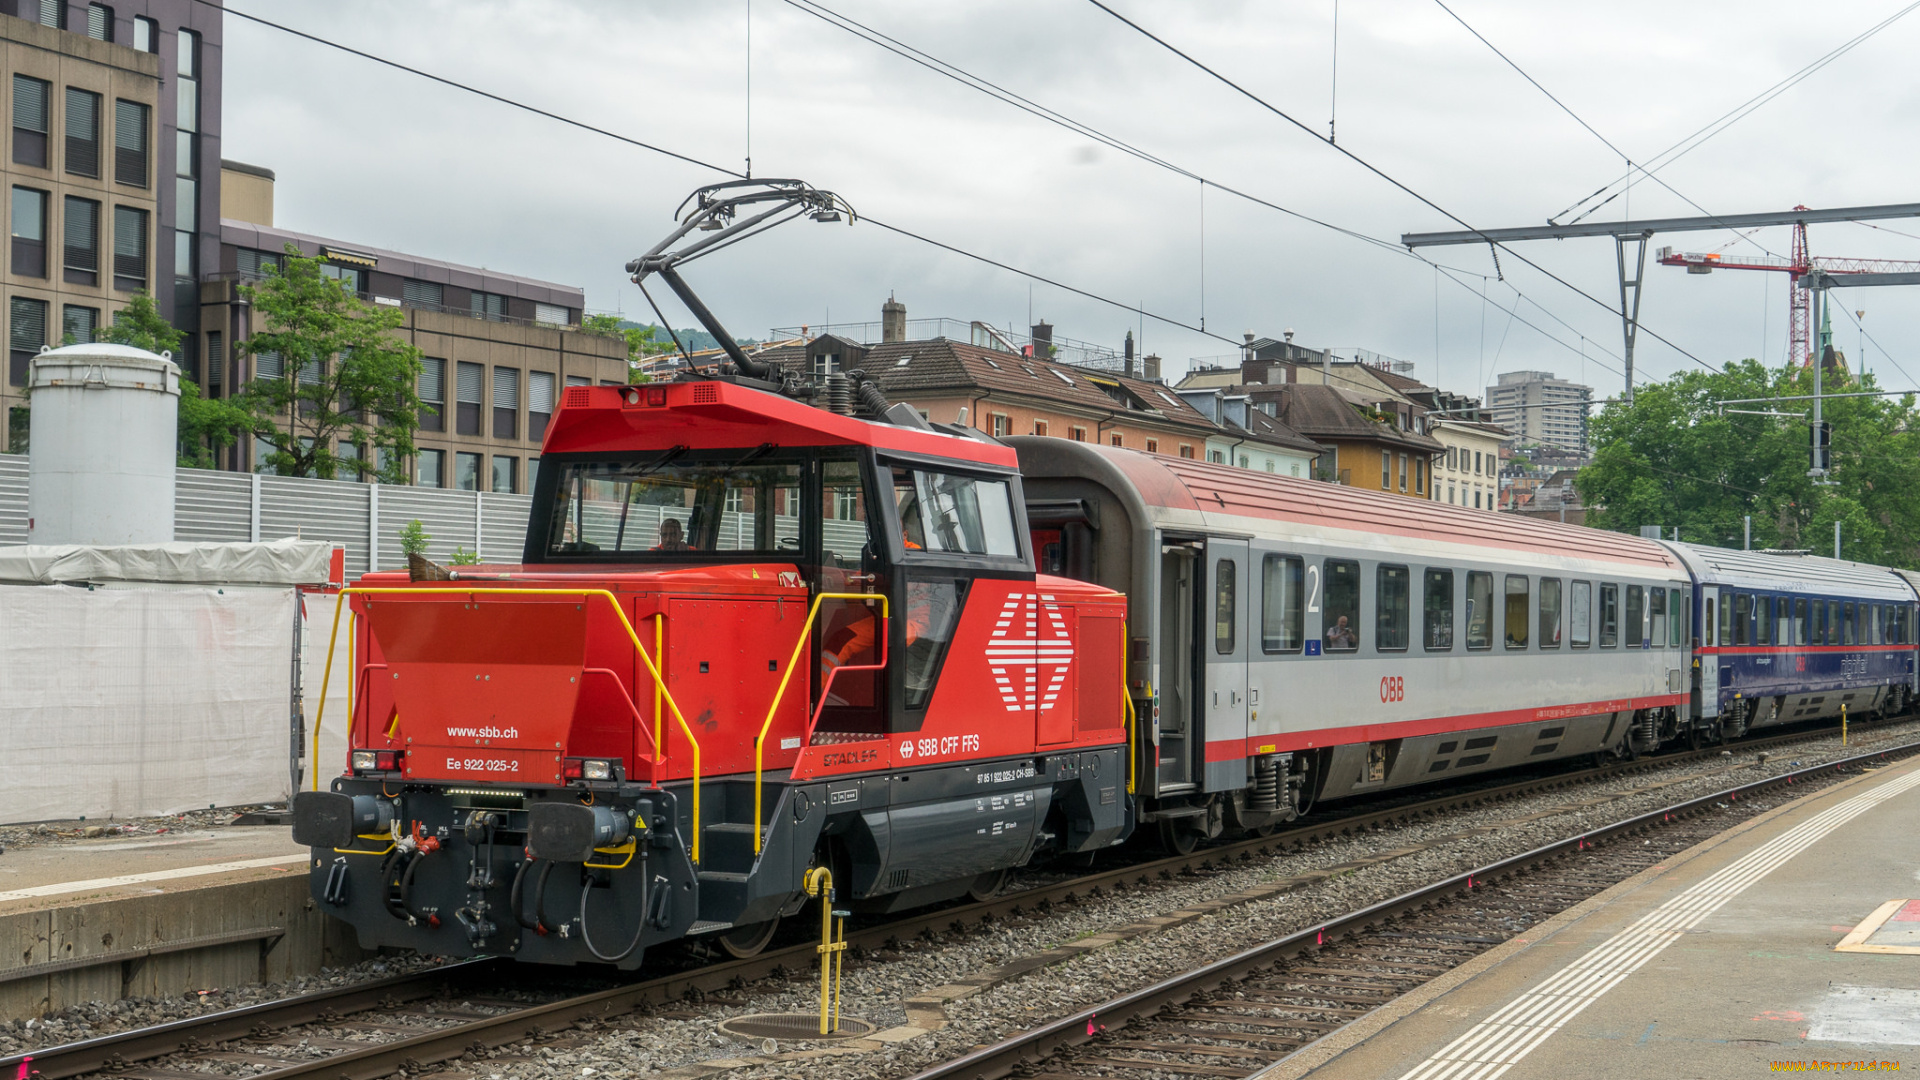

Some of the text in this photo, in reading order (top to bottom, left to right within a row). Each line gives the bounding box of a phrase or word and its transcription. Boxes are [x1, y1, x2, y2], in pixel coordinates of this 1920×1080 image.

[1308, 565, 1319, 612] 2
[1643, 591, 1650, 622] 2
[1750, 594, 1757, 621] 2
[1380, 676, 1404, 703] ÖBB
[447, 726, 518, 738] www.sbb.ch
[918, 734, 980, 757] SBB CFF FFS
[446, 758, 518, 772] Ee 922 025-2
[823, 749, 878, 767] STADLER
[994, 771, 1002, 782] 922
[1003, 770, 1015, 781] 025-2
[1016, 768, 1034, 779] CH-SBB
